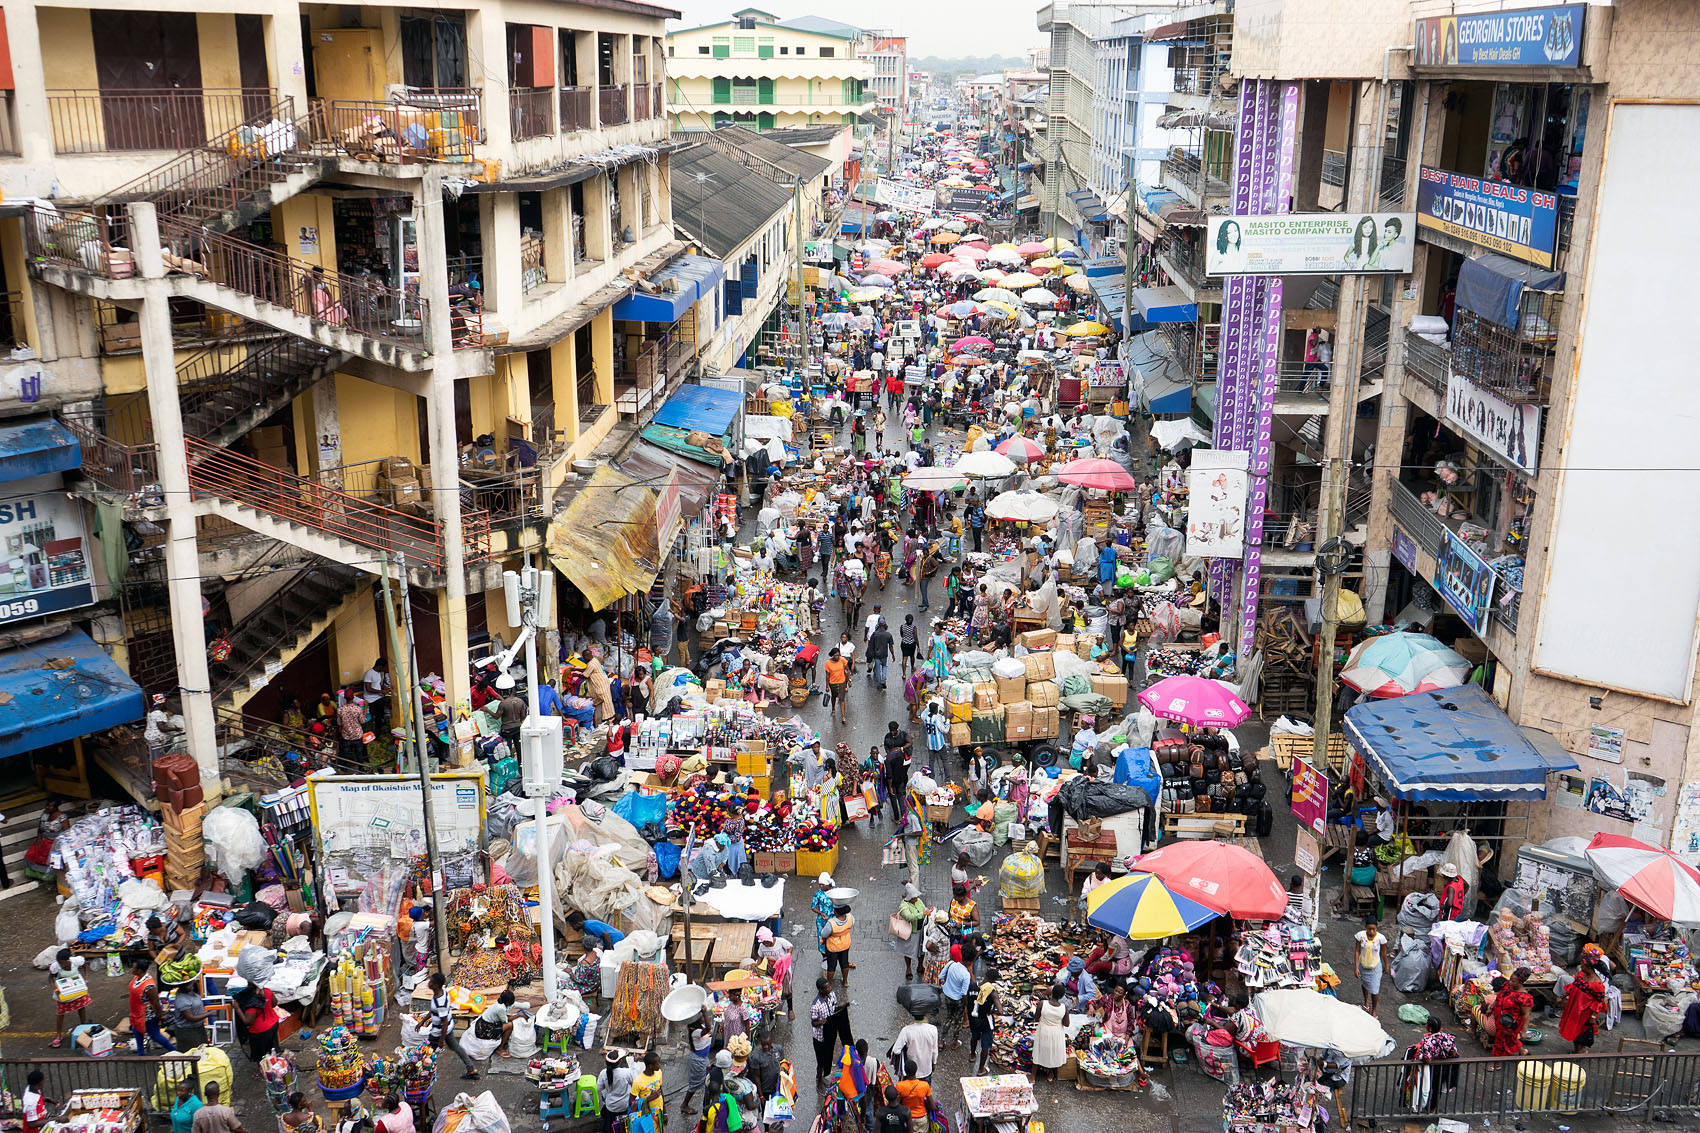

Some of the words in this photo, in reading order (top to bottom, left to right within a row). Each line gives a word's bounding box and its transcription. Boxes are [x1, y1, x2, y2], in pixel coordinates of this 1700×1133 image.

[1459, 19, 1504, 44] GEORGINA
[1506, 15, 1544, 42] STORES
[1473, 50, 1478, 62] by
[1479, 48, 1488, 60] Best
[1489, 47, 1498, 59] Hair
[1499, 47, 1511, 59] Deals
[1512, 47, 1521, 59] GH
[1421, 168, 1448, 184] BEST
[1451, 175, 1479, 192] HAIR
[1482, 181, 1527, 203] DEALS
[1531, 193, 1555, 210] GH
[1451, 225, 1460, 235] 0249
[1481, 235, 1492, 246] 0543
[1503, 242, 1512, 252] 102
[0, 500, 36, 524] SH
[0, 599, 39, 618] 059
[1302, 771, 1314, 784] 4G
